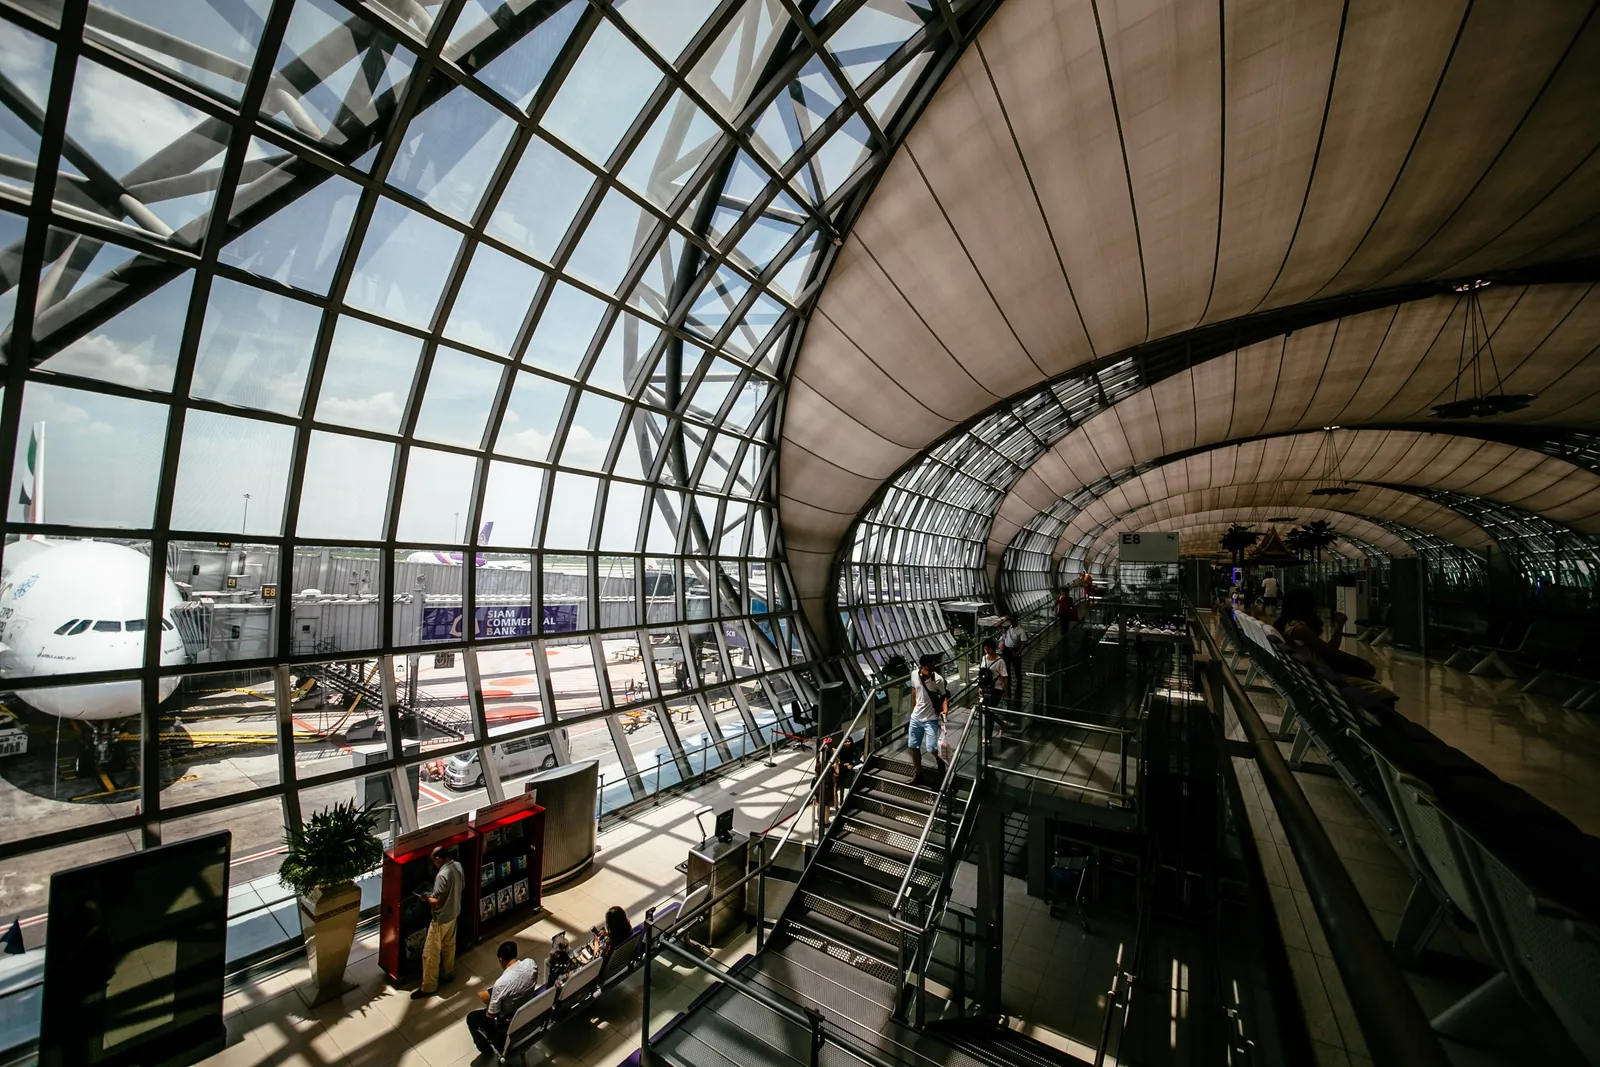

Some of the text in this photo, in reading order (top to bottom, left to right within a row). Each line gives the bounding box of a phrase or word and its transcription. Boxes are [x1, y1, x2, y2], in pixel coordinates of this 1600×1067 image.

[1122, 533, 1141, 545] E8
[264, 588, 276, 597] E8
[487, 609, 515, 619] SIAM
[486, 617, 556, 627] COMMERAL
[486, 626, 517, 636] BANK
